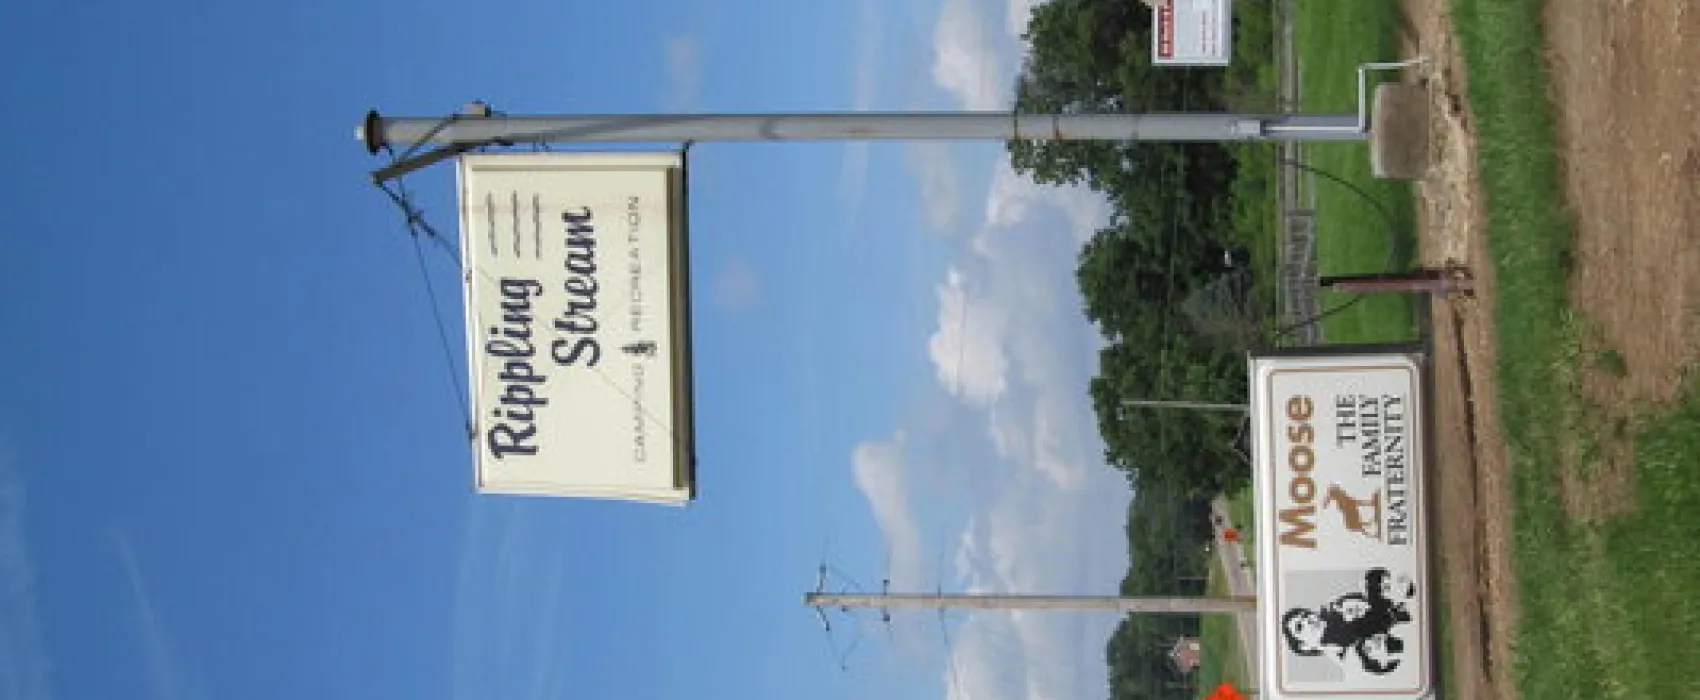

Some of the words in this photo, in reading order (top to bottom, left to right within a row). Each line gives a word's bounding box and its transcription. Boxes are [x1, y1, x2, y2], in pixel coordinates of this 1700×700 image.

[551, 205, 601, 368] Stream
[626, 195, 643, 332] RECREATION
[485, 277, 549, 460] Rippling
[1335, 393, 1357, 449] THE
[1358, 393, 1382, 479] FAMILY
[1278, 395, 1318, 549] Moose
[1381, 393, 1408, 547] FRATERNITY
